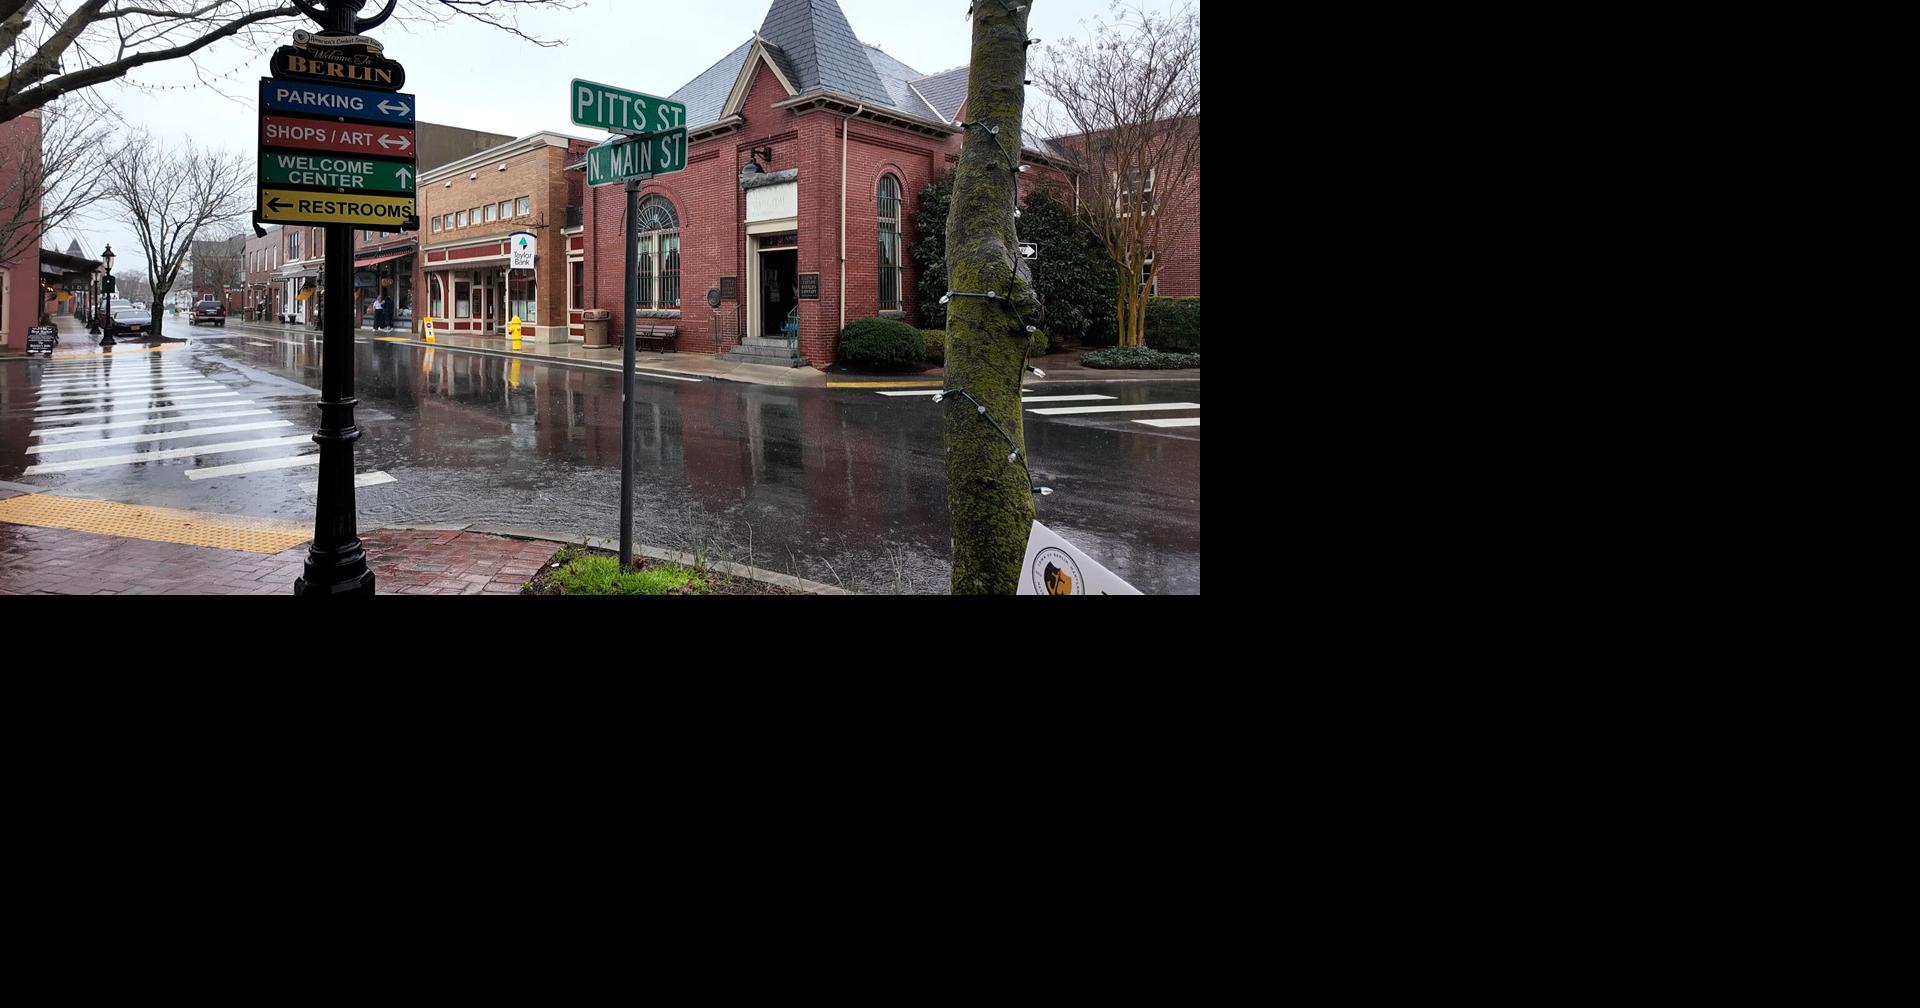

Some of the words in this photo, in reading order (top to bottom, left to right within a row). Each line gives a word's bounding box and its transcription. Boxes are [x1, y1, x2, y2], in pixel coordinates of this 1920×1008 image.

[308, 47, 352, 62] Welcome
[354, 54, 371, 65] To
[287, 54, 393, 84] BERLIN
[276, 88, 364, 111] PARKING
[577, 86, 647, 130] PITTS
[657, 103, 683, 131] ST
[266, 124, 327, 143] SHOPS
[330, 129, 336, 143] /
[339, 131, 374, 147] ART
[277, 155, 374, 175] WELCOME
[590, 151, 604, 181] N.
[610, 140, 652, 178] MAIN
[660, 132, 683, 169] ST
[288, 171, 365, 188] CENTER
[298, 200, 412, 219] RESTROOMS
[513, 250, 532, 260] Taylor
[514, 258, 530, 266] Bank
